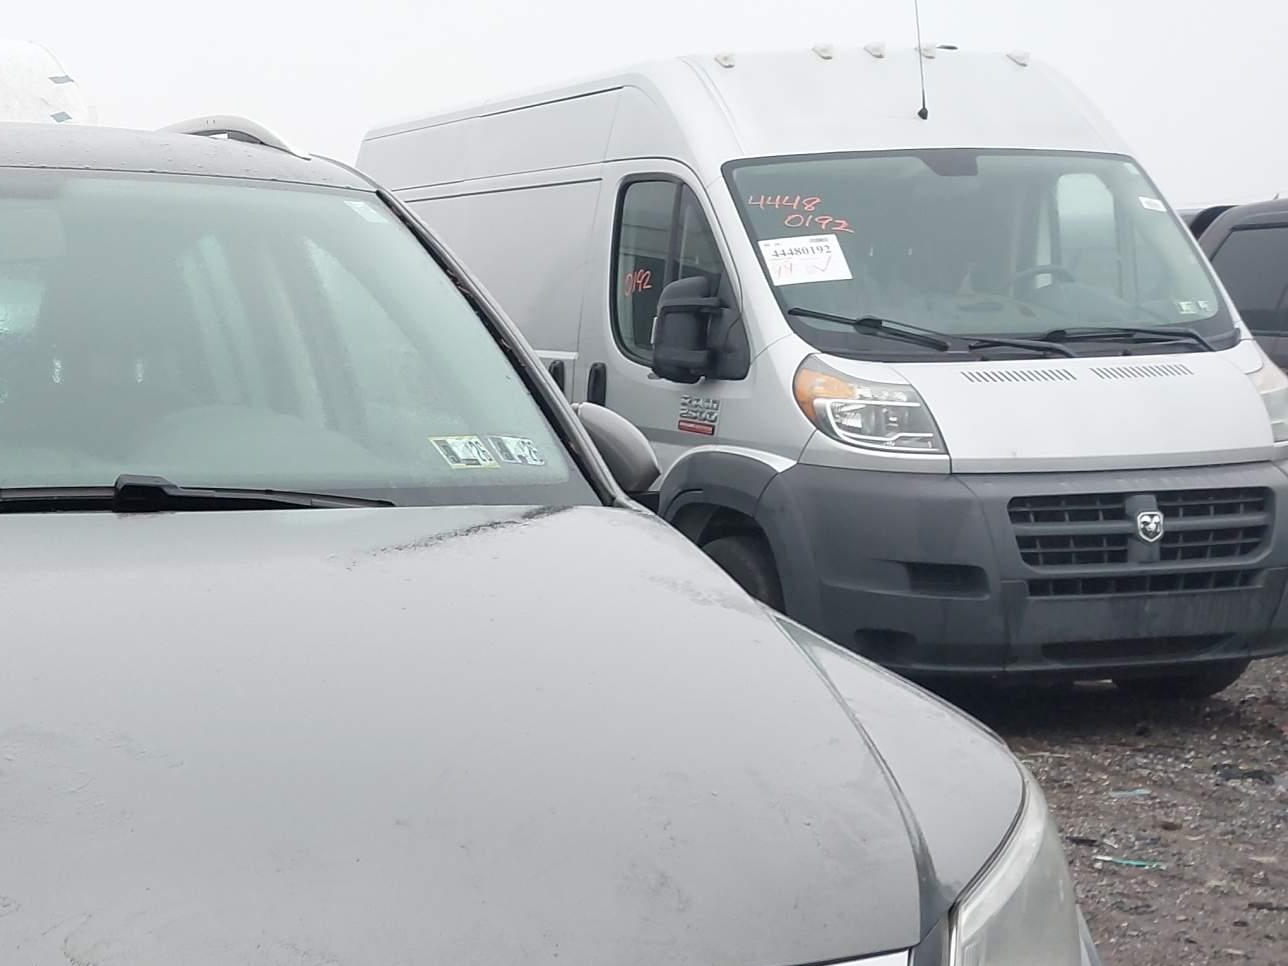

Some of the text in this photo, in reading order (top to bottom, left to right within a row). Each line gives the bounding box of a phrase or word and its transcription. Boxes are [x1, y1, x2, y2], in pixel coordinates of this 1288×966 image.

[748, 195, 821, 211] 4448
[784, 214, 855, 233] 0192
[771, 244, 832, 257] 44480192
